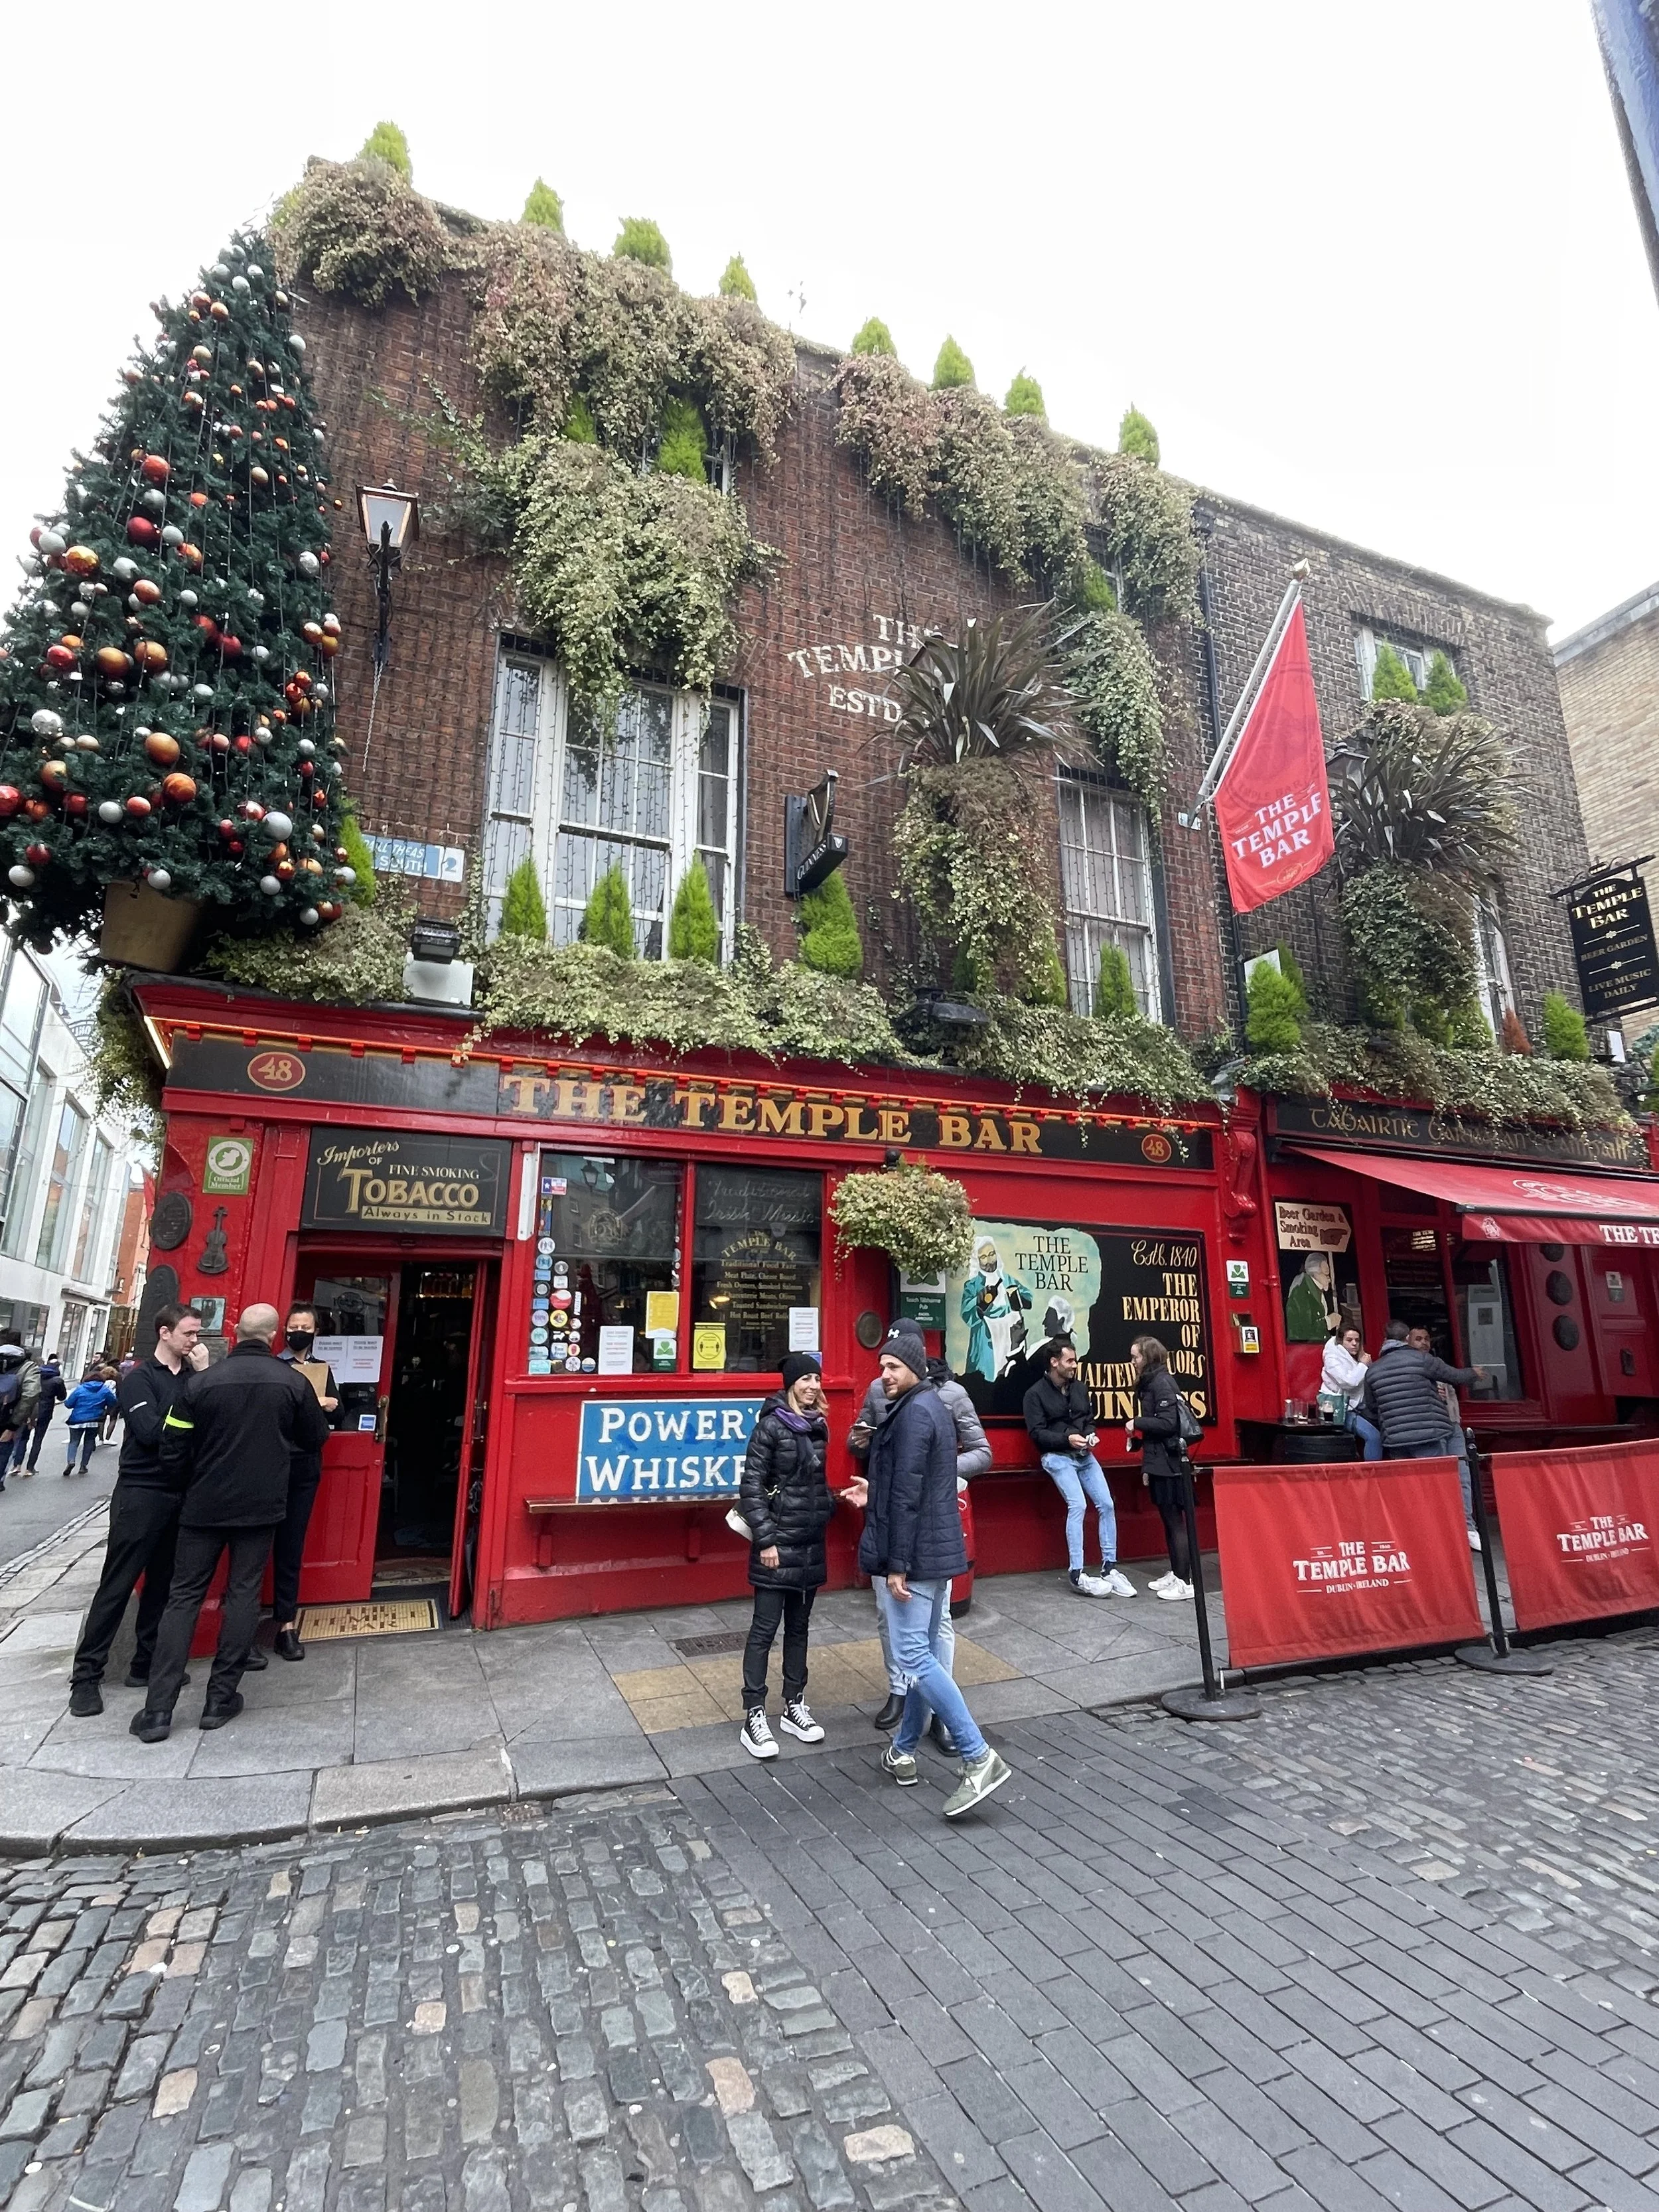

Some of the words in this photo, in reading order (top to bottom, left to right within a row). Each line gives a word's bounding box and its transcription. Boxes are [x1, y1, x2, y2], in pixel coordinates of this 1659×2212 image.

[787, 644, 910, 678] TEMPL
[1254, 793, 1297, 825] THE
[1231, 792, 1321, 860] TEMPLE
[392, 844, 425, 858] THEAS
[1259, 829, 1312, 869] BAR
[379, 855, 427, 872] SOUTH
[445, 857, 457, 873] 2
[1593, 883, 1617, 898] THE
[1571, 887, 1644, 920] TEMPLE
[1589, 908, 1630, 929] BAR
[1581, 945, 1605, 962] BEER
[1607, 934, 1649, 953] GARDEN
[1588, 978, 1614, 993] LIVE
[1615, 968, 1652, 986] MUSIC
[1603, 982, 1639, 999] DAILY
[257, 1057, 293, 1082] 48
[502, 1074, 648, 1123] THE
[674, 1090, 912, 1143] TEMPLE
[938, 1114, 1043, 1154] BAR
[317, 1140, 399, 1167] Importers
[1145, 1139, 1165, 1157] 48
[368, 1156, 383, 1165] OF
[389, 1164, 417, 1176] FINE
[421, 1166, 480, 1179] SMOKING
[336, 1167, 479, 1214] TOBACCO
[364, 1205, 418, 1220] Always
[427, 1210, 440, 1221] in
[446, 1211, 489, 1224] Stock
[1278, 1205, 1299, 1220] Beer
[1301, 1207, 1336, 1223] Garden
[1279, 1220, 1319, 1237] Smoking
[1599, 1224, 1638, 1243] THE
[721, 1236, 770, 1258] TEMPLE
[774, 1241, 796, 1261] BAR
[1033, 1235, 1071, 1254] THE
[1289, 1234, 1311, 1248] Area
[1015, 1252, 1088, 1274] TEMPLE
[1170, 1244, 1198, 1268] 1840
[1035, 1272, 1074, 1293] BAR
[1162, 1272, 1197, 1296] THE
[1121, 1296, 1201, 1323] EMPEROR
[1181, 1323, 1200, 1349] OF
[598, 1407, 761, 1443] POWER'
[585, 1454, 747, 1492] WHISKE
[1589, 1515, 1615, 1530] THE
[1338, 1541, 1366, 1557] THE
[1556, 1529, 1617, 1552] TEMPLE
[1618, 1522, 1649, 1544] BAR
[1293, 1556, 1368, 1581] TEMPLE
[1371, 1551, 1411, 1574] BAR
[1326, 1582, 1353, 1593] DUBLIN
[1356, 1578, 1390, 1590] IRELAND
